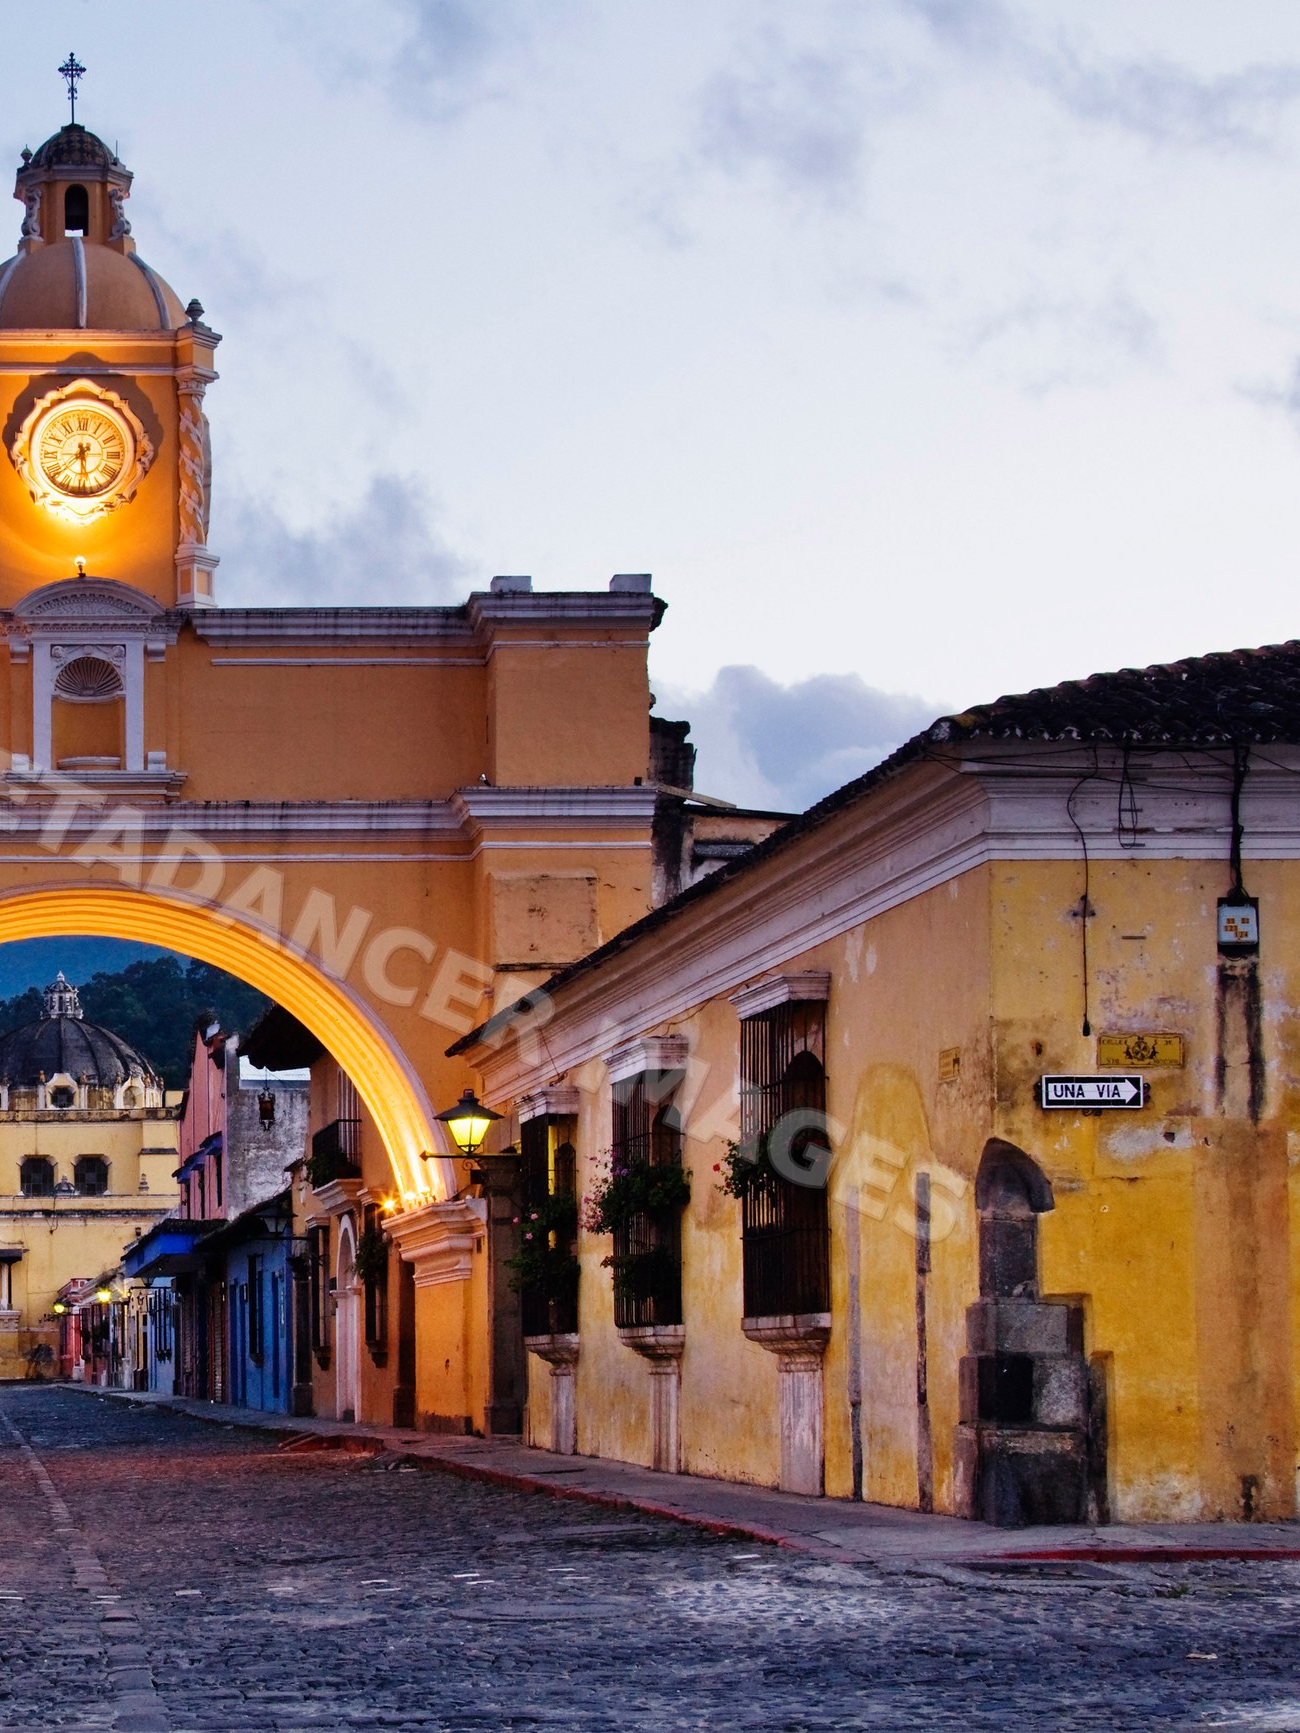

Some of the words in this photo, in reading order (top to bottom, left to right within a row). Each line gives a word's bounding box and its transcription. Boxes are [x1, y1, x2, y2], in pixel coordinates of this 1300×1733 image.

[102, 434, 116, 445] II
[106, 451, 120, 460] III
[1053, 1084, 1085, 1098] UNA
[1096, 1084, 1121, 1098] VIA
